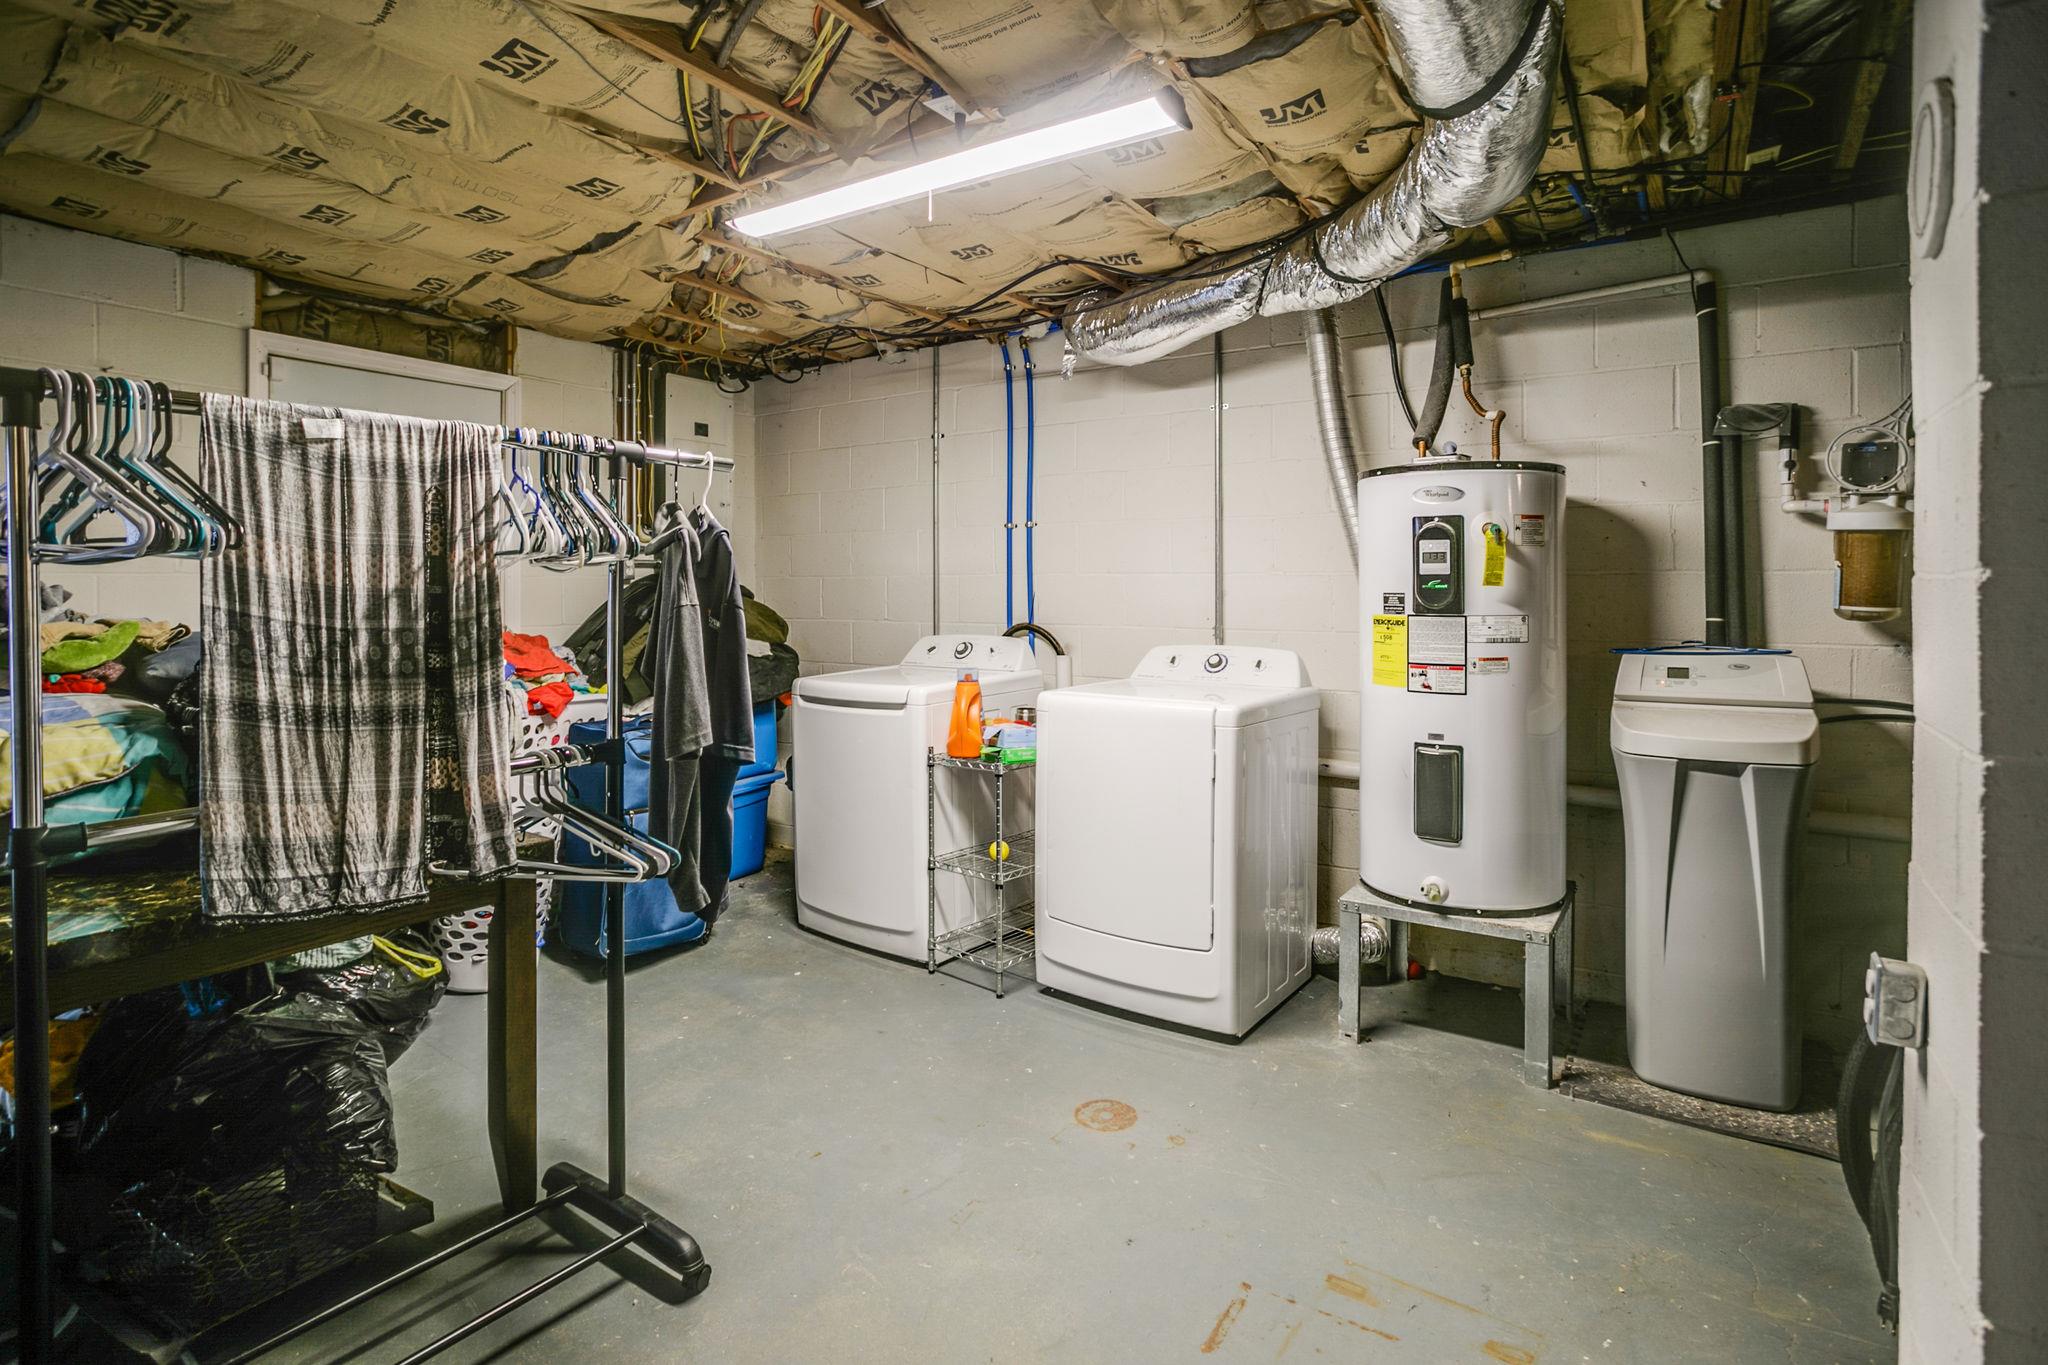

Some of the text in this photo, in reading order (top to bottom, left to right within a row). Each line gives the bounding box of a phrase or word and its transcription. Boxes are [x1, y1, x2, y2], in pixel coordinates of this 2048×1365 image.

[1007, 11, 1042, 30] Thermal
[1189, 11, 1243, 47] Thermal and
[967, 31, 992, 45] Sound
[992, 25, 1008, 36] and
[479, 37, 550, 79] JM
[1260, 88, 1326, 124] JM
[1290, 108, 1328, 125] Manville
[565, 177, 621, 197] JM
[299, 204, 351, 224] JM
[454, 205, 505, 223] JM
[951, 243, 994, 262] JM
